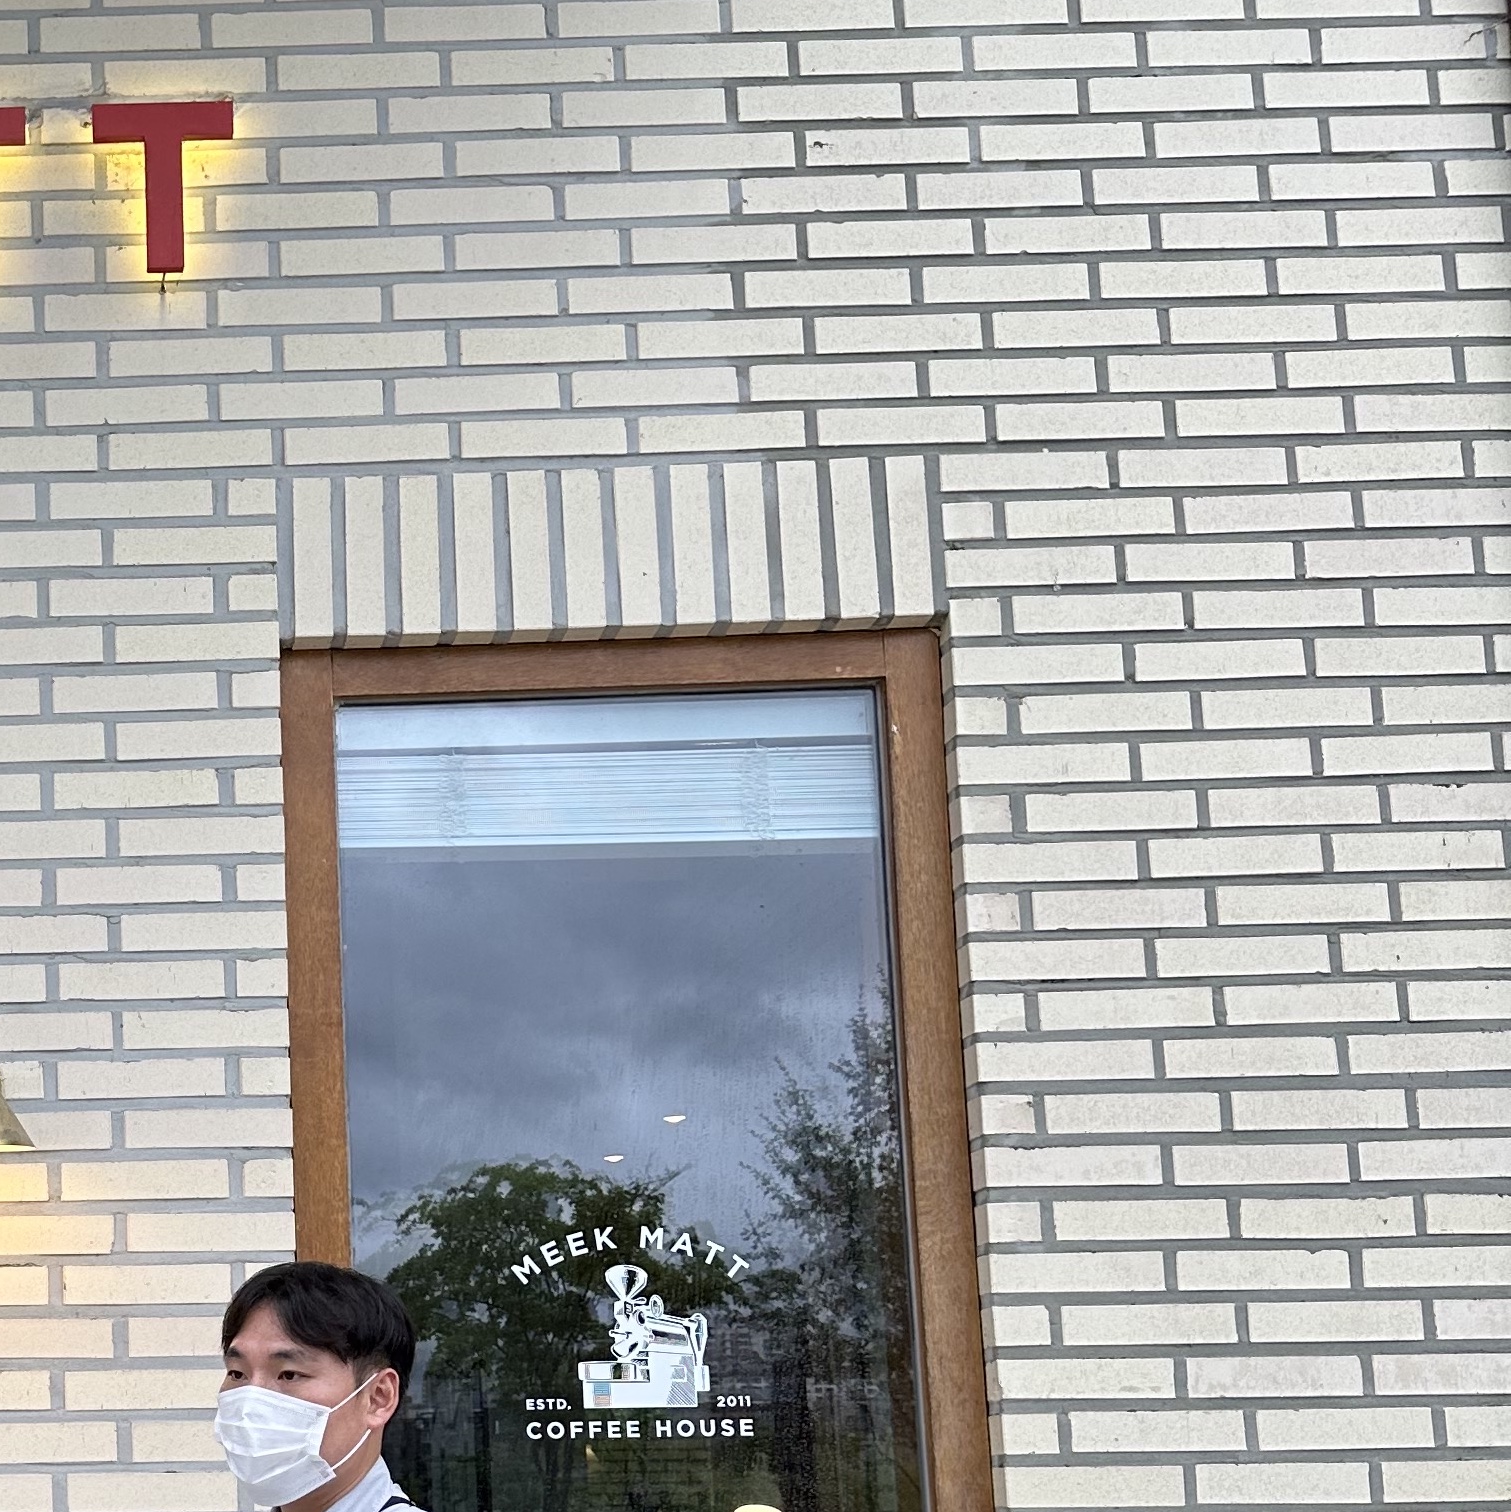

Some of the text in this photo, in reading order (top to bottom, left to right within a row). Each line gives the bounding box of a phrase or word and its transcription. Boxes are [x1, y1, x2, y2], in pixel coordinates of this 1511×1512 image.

[510, 1225, 750, 1285] MEEK MATT
[525, 1395, 751, 1411] ESTD. 2011
[526, 1418, 755, 1440] COFFEE HOUSE
